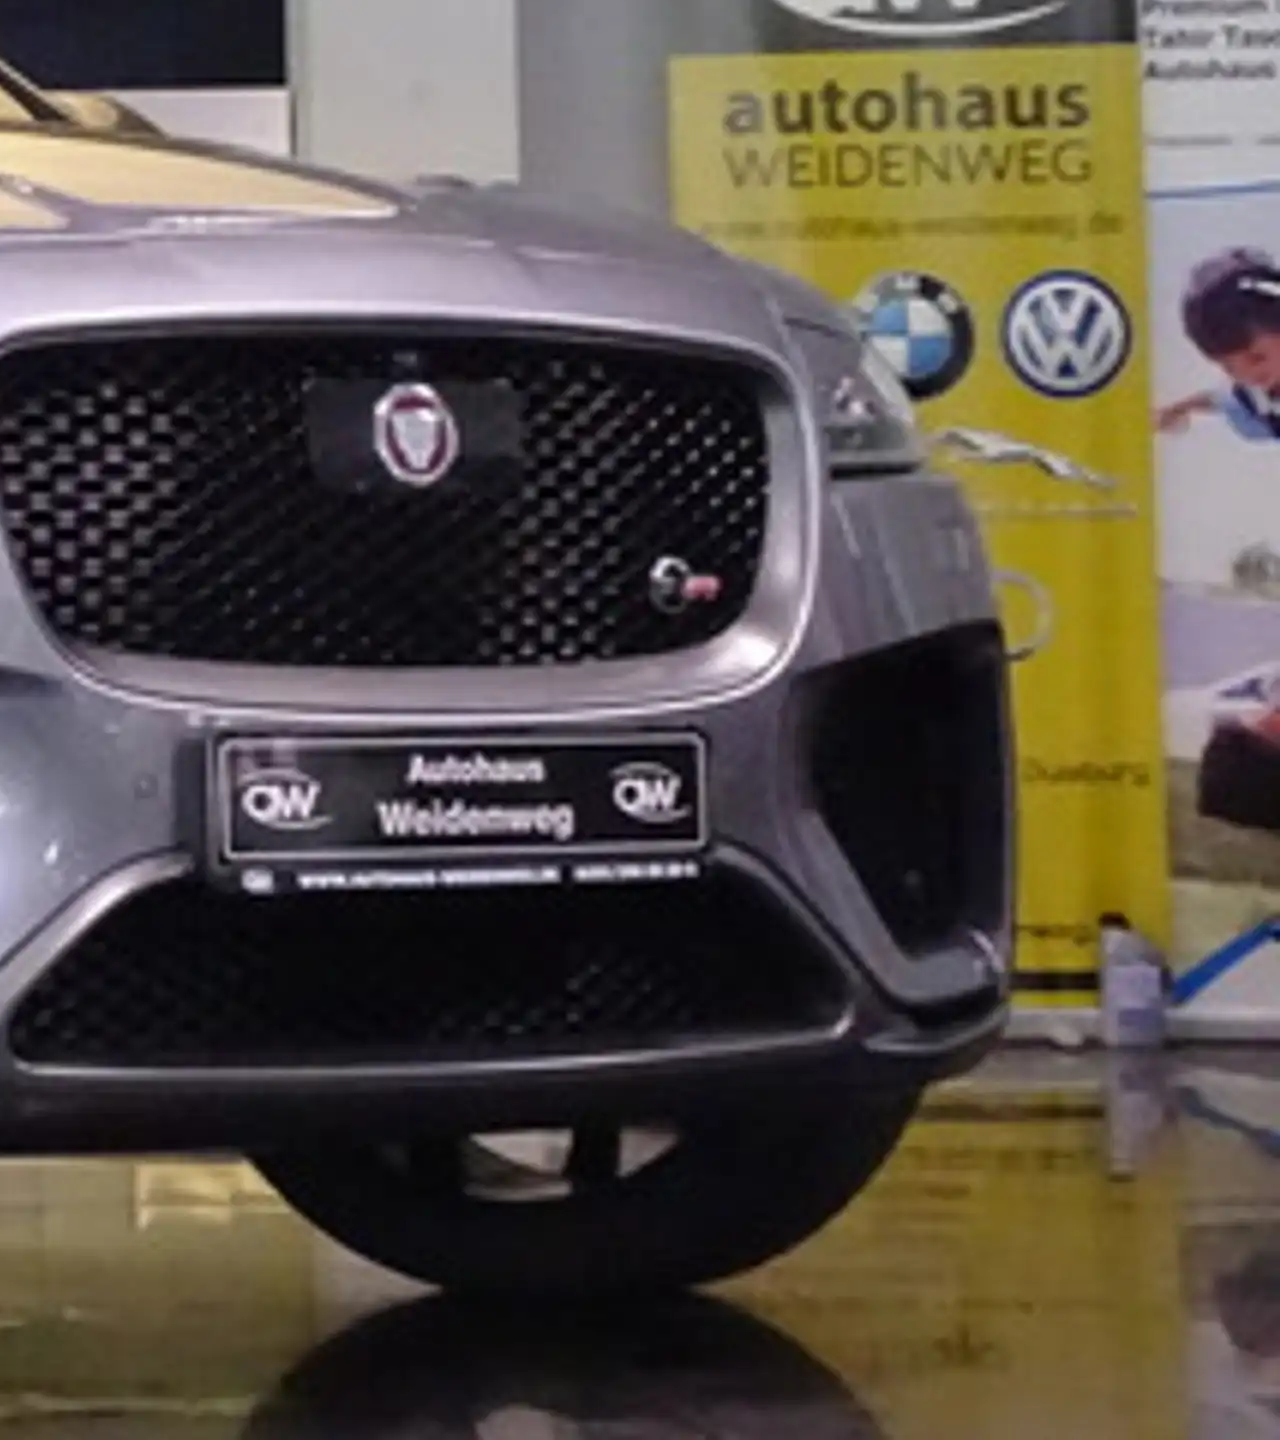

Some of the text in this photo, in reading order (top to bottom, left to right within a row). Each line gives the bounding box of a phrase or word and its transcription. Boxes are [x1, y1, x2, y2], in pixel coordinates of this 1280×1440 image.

[723, 72, 1092, 137] autohaus
[721, 138, 1093, 190] WEIDENWEG
[405, 755, 545, 786] Autohaus
[376, 800, 575, 841] Weidenweg
